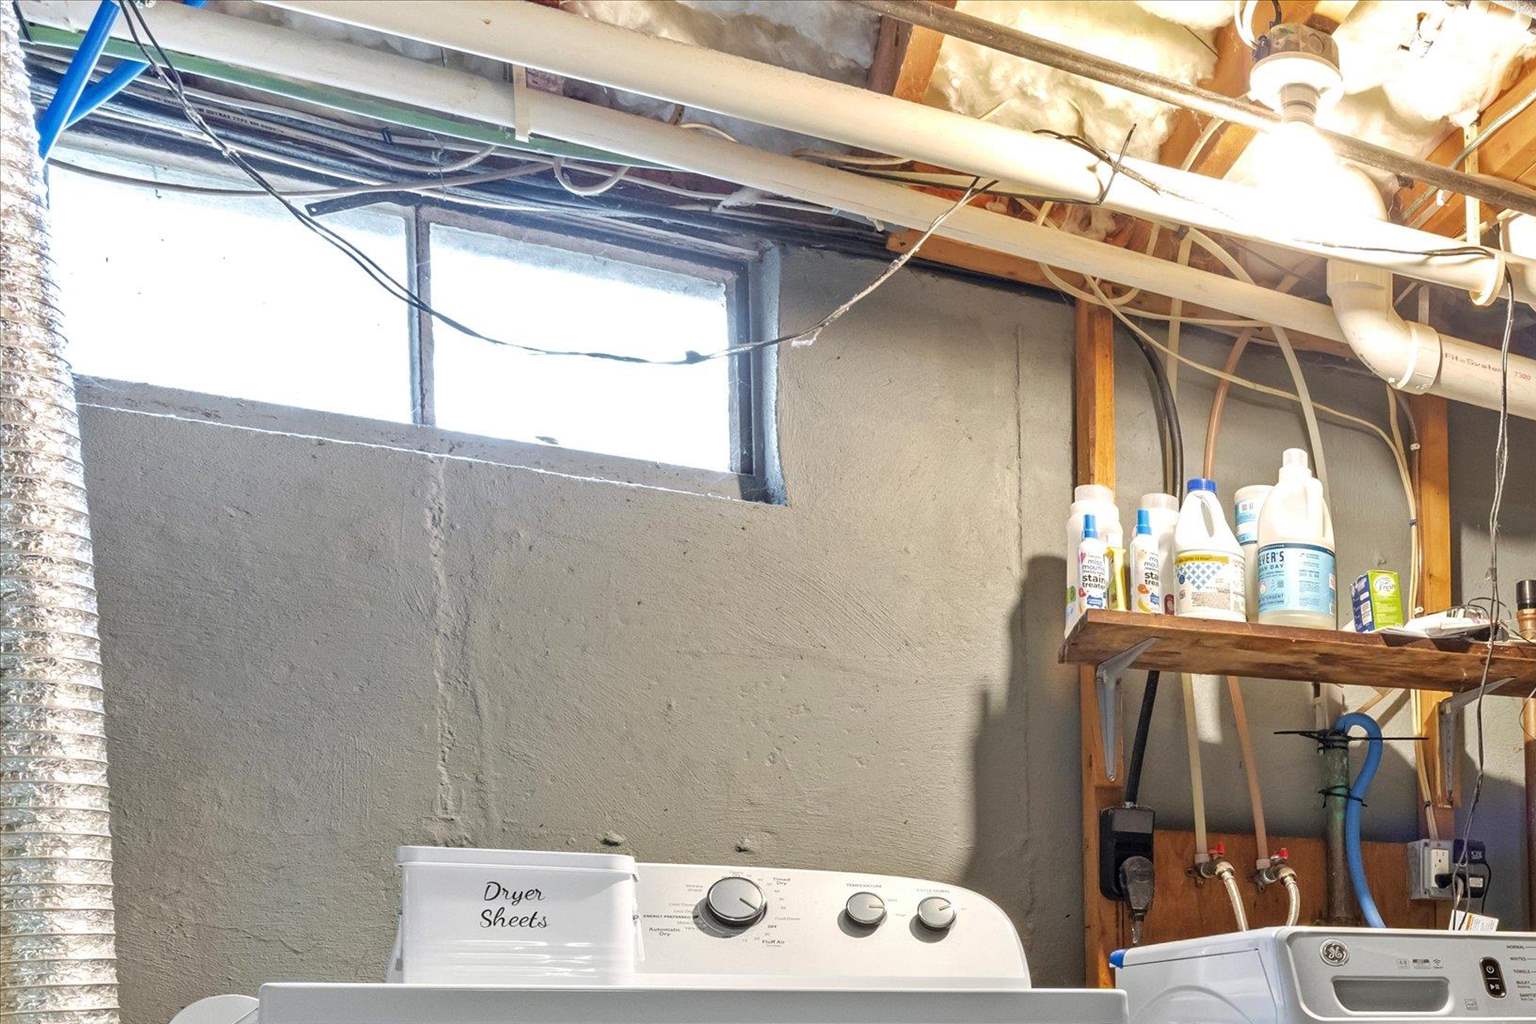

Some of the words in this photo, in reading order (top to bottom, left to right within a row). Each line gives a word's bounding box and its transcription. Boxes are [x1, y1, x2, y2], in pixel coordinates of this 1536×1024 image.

[1082, 574, 1106, 583] stain
[484, 881, 545, 906] Dryer
[480, 906, 547, 929] Sheets
